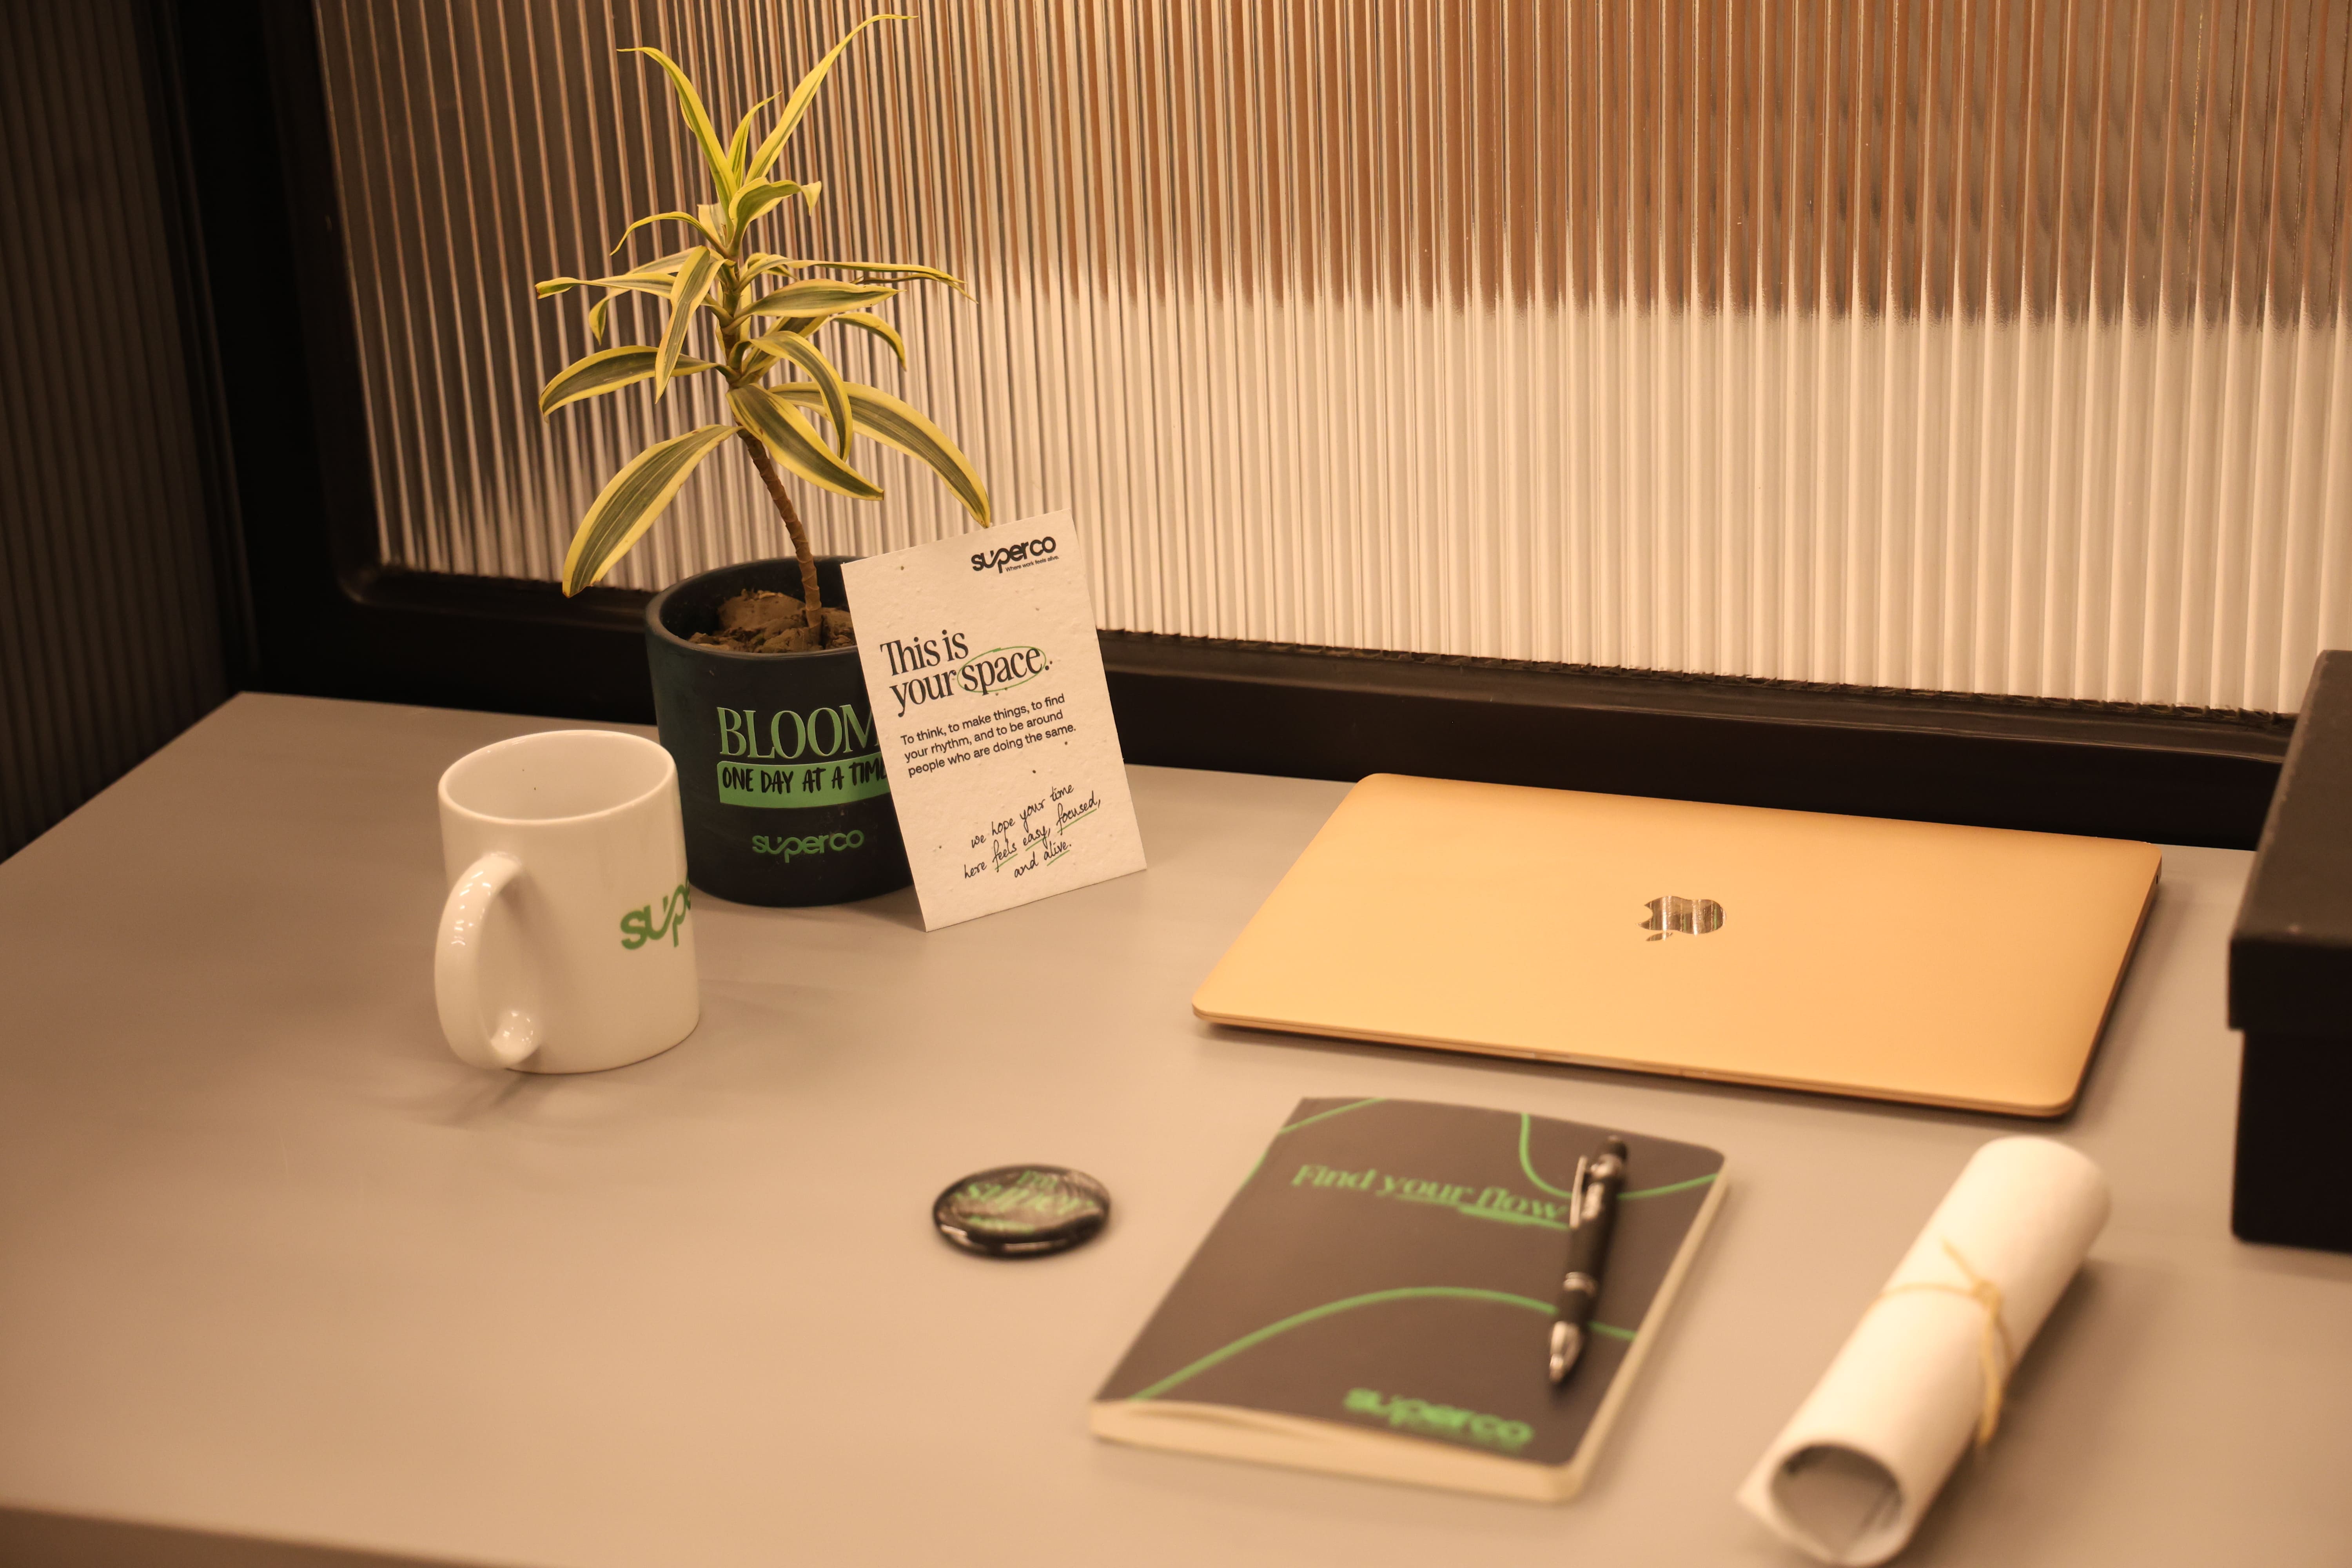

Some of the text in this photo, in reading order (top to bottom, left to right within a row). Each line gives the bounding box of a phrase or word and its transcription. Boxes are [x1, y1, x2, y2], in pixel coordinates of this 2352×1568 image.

[971, 537, 1056, 573] superco
[880, 630, 969, 676] This is
[889, 648, 1049, 717] your space.
[717, 704, 881, 759] BLOOM
[900, 693, 1065, 745] To think, to make things, to find
[904, 709, 1063, 763] your rhythm, and to be around
[908, 724, 1076, 778] people who are doing the same.
[722, 766, 753, 791] ONE
[760, 770, 793, 794] DAY
[803, 768, 826, 793] AT
[832, 766, 844, 790] A
[964, 790, 1101, 878] here feels easy, focused,
[971, 784, 1074, 848] we hope your time
[752, 829, 864, 863] superco
[1014, 841, 1071, 878] and alive.
[1291, 1164, 1378, 1191] Find
[1376, 1175, 1474, 1207] your
[1475, 1187, 1569, 1219] flow
